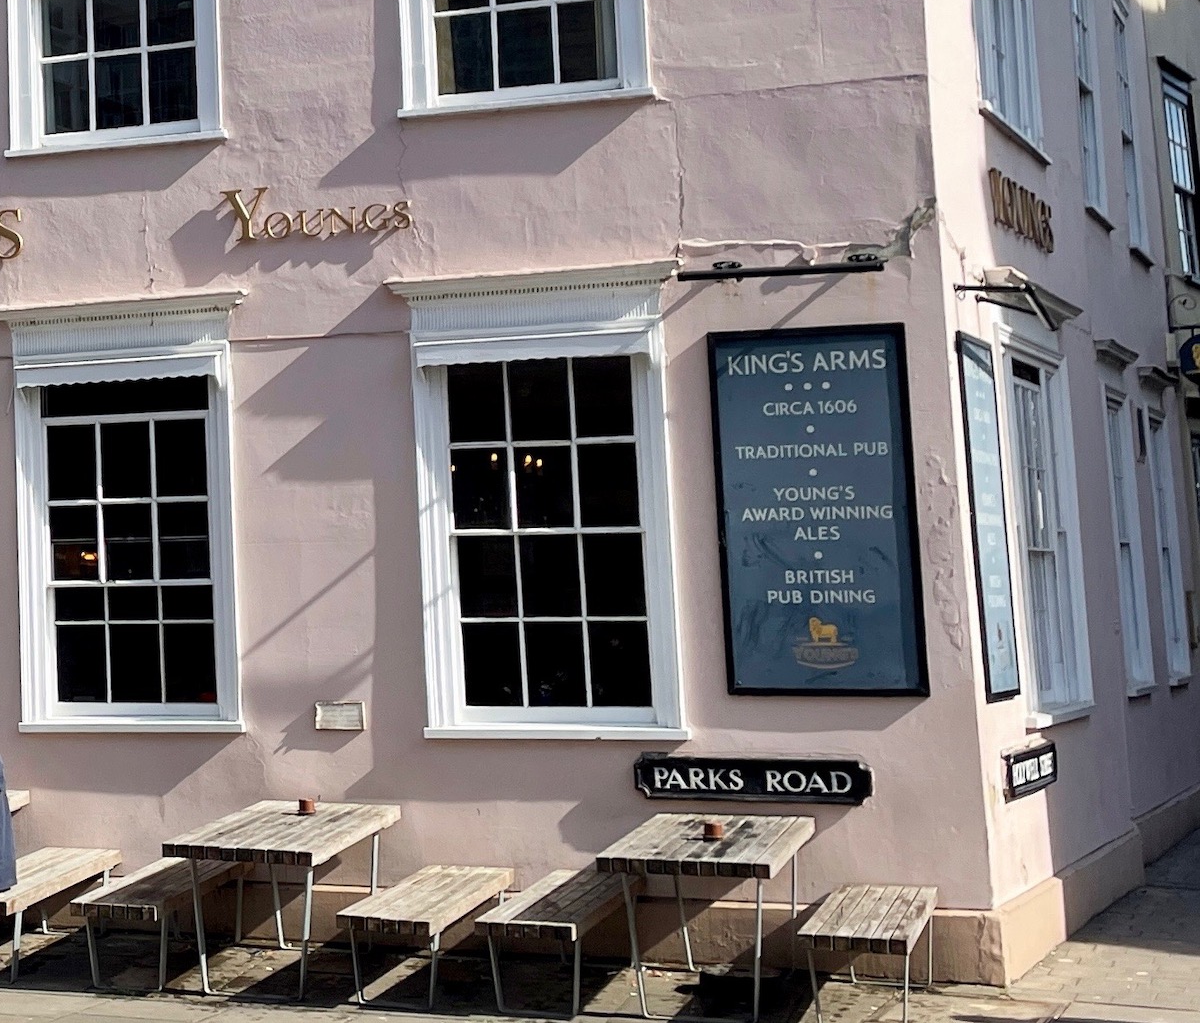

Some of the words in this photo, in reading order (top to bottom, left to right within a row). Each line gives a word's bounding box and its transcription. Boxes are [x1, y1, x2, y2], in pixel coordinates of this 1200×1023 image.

[220, 187, 412, 242] YOUNGS
[727, 351, 804, 375] KING'S
[813, 348, 887, 373] ARMS
[763, 401, 814, 417] CIRCA
[817, 400, 857, 415] 1606
[735, 443, 848, 460] TRADITIONAL
[853, 442, 888, 456] PUB
[773, 486, 855, 501] YOUNG'S
[742, 507, 804, 522] AWARD
[810, 505, 893, 520] WINNING
[794, 526, 840, 541] ALES
[784, 570, 854, 584] BRITISH
[767, 590, 803, 604] PUB
[810, 589, 876, 604] DINING
[654, 767, 744, 790] PARKS
[766, 770, 852, 794] ROAD
